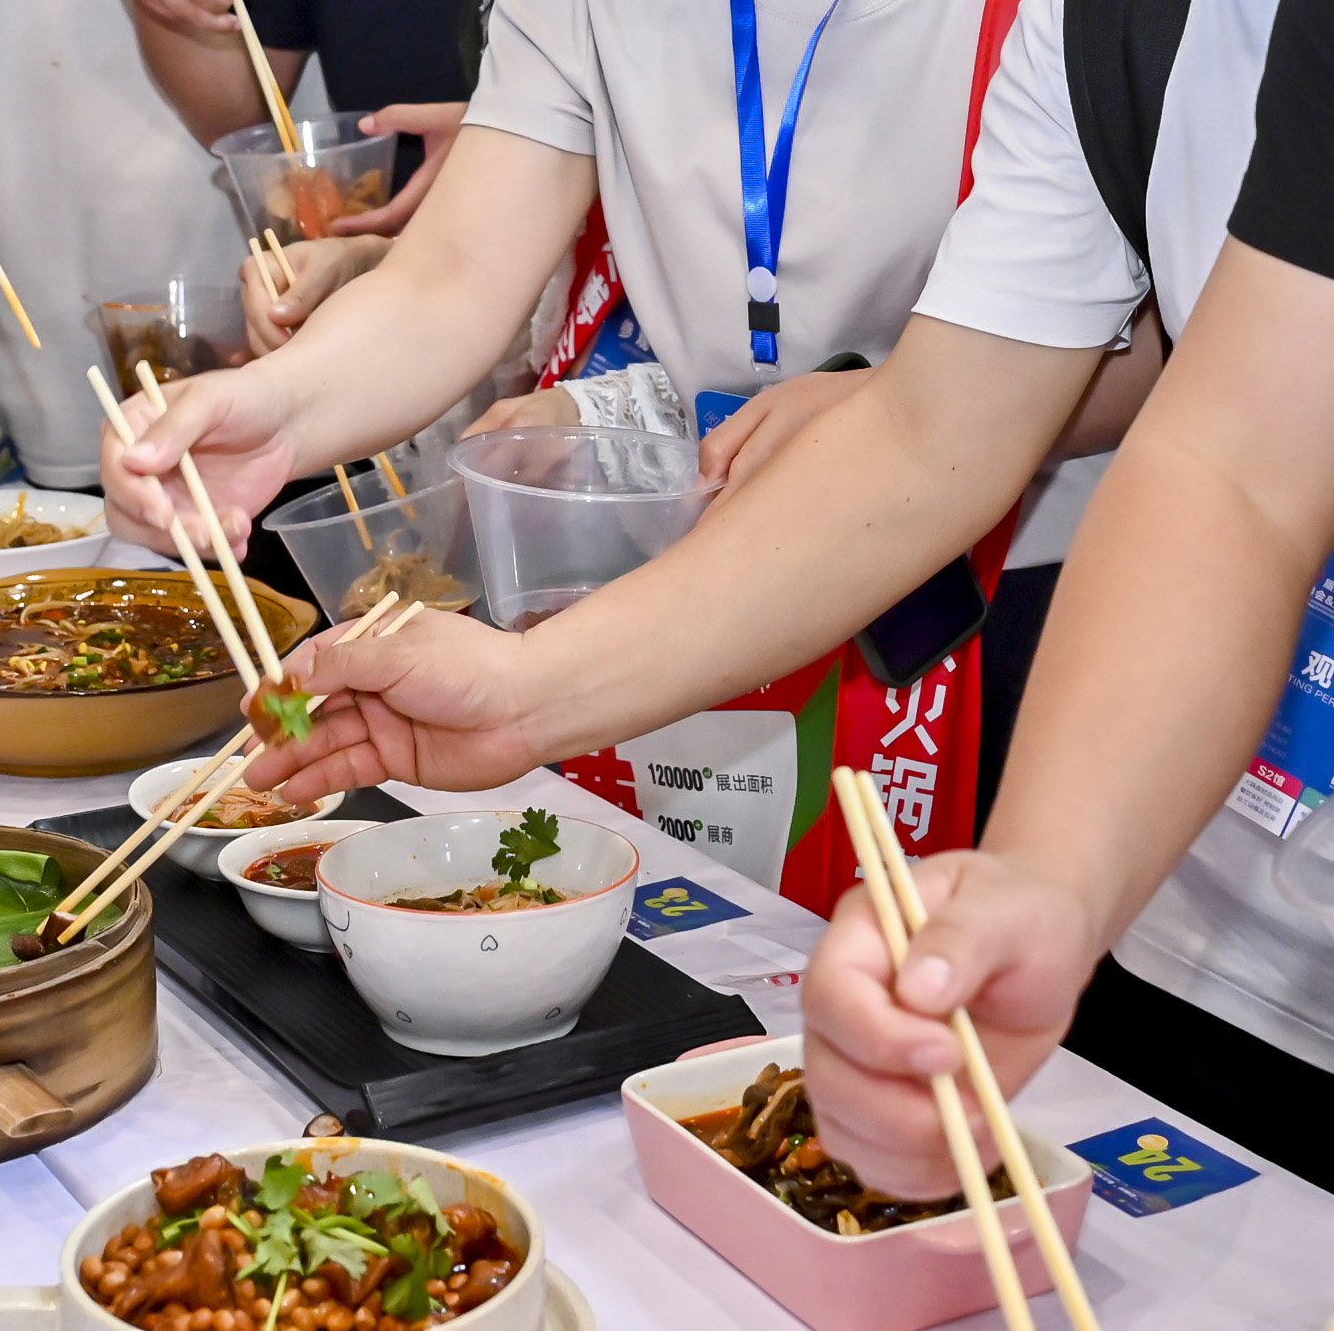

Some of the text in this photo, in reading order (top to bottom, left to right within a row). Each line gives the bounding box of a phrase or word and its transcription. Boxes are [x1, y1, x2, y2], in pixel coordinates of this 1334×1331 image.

[1288, 673, 1313, 694] TING
[716, 773, 773, 795] 展出面积
[707, 825, 733, 845] 展商
[1118, 1146, 1203, 1181] 24
